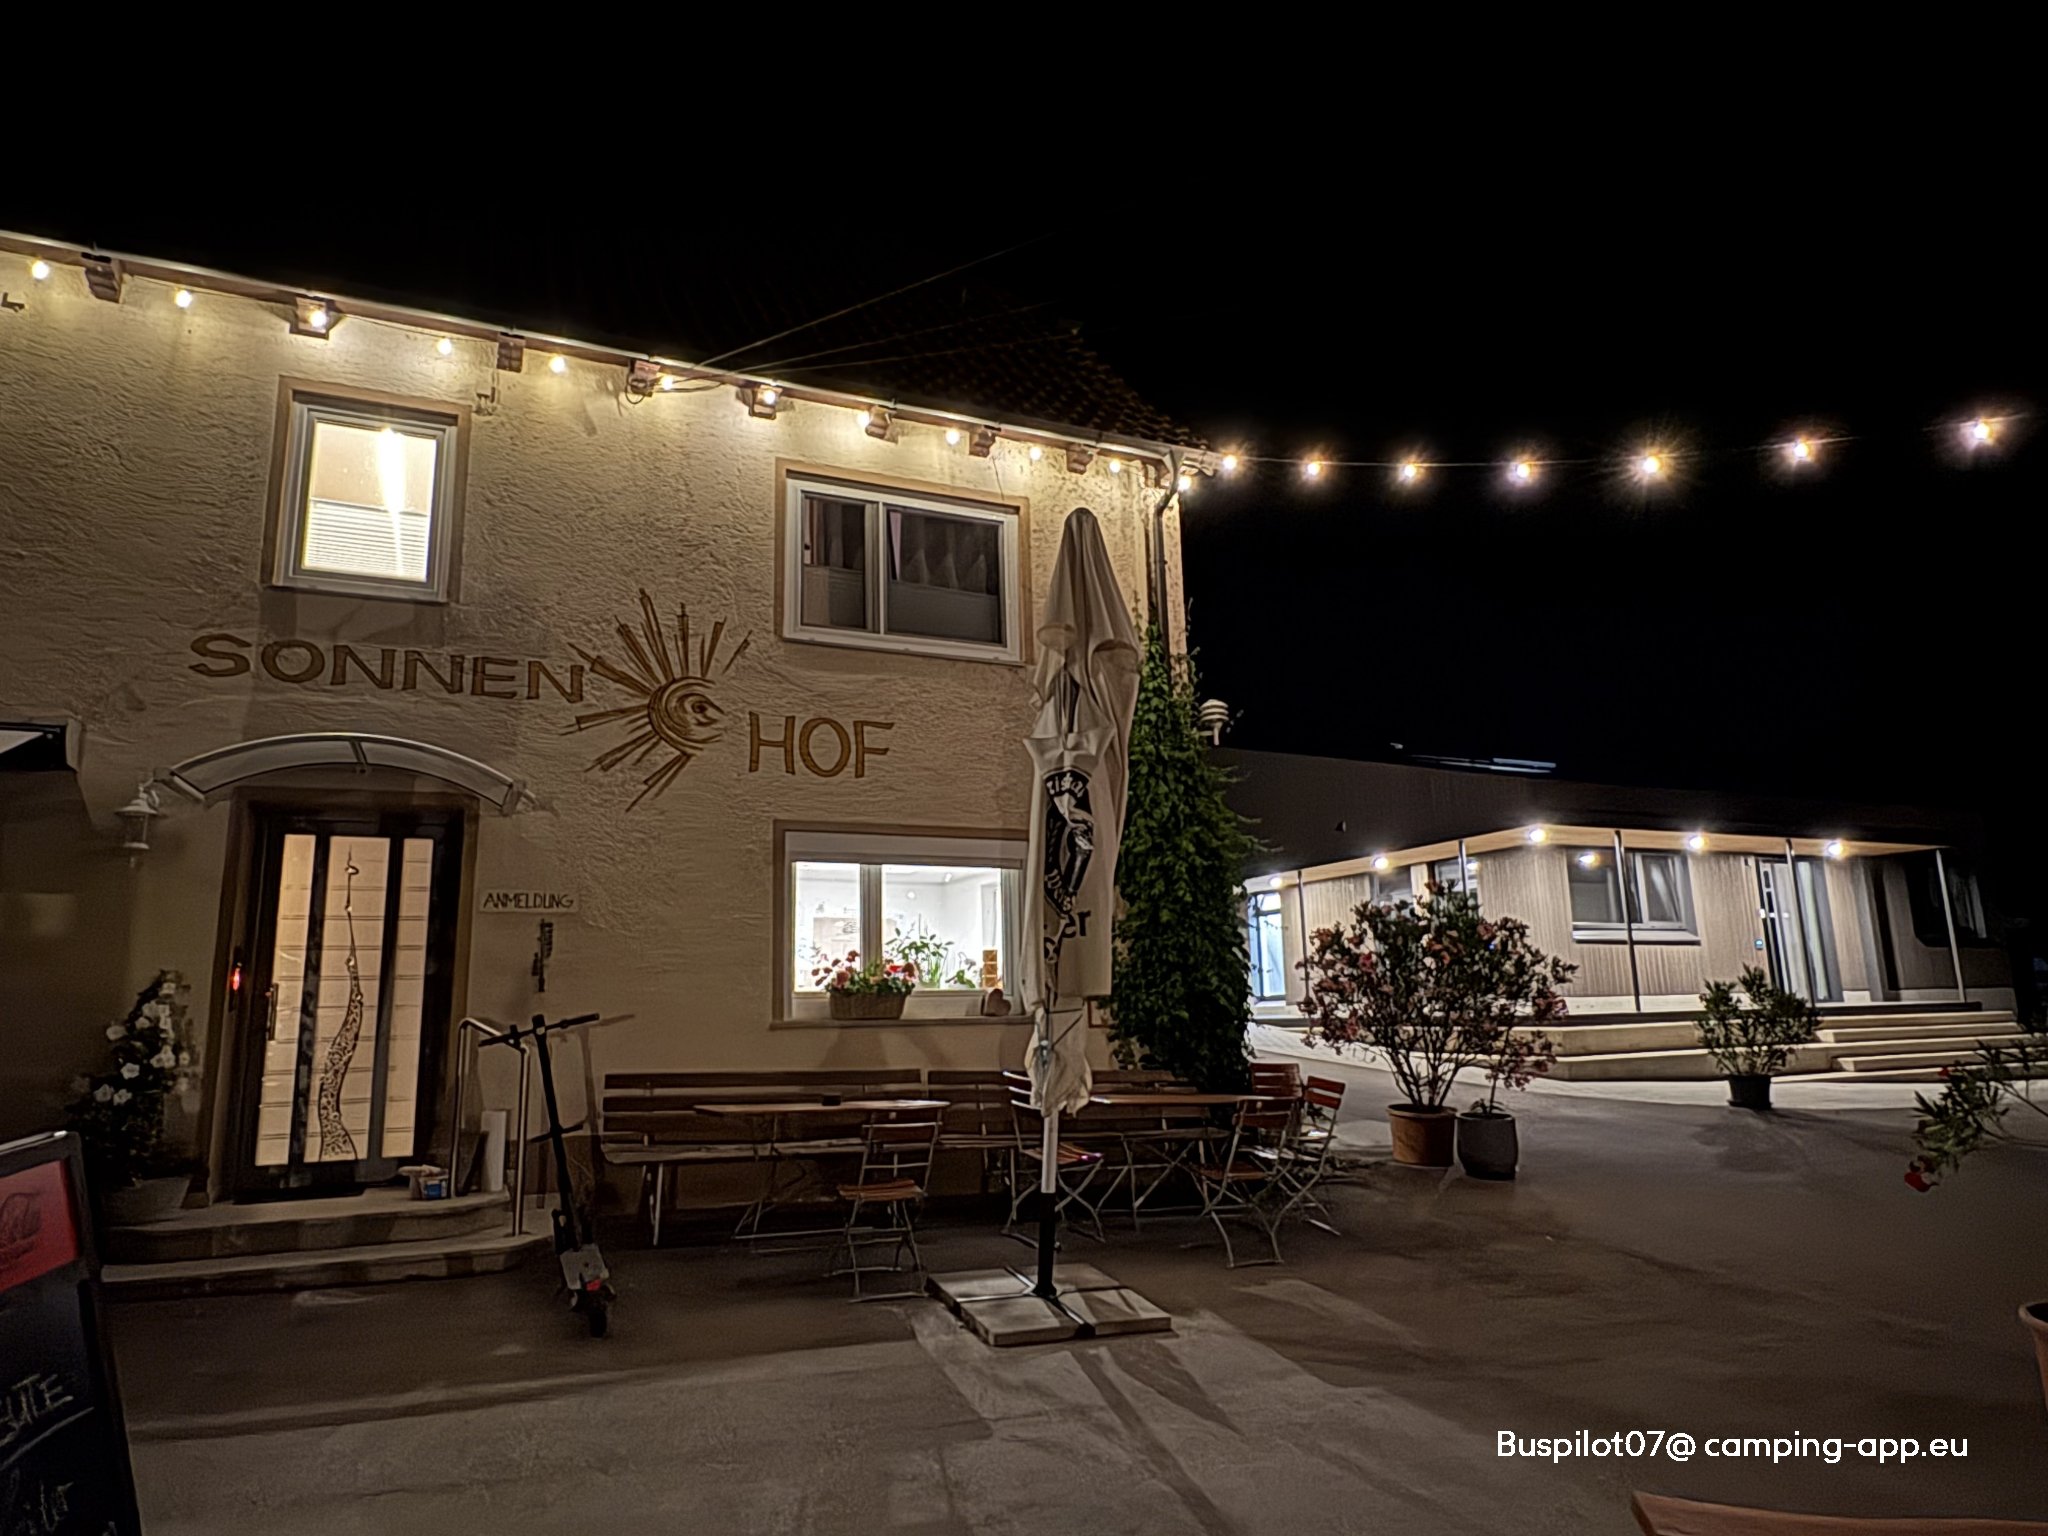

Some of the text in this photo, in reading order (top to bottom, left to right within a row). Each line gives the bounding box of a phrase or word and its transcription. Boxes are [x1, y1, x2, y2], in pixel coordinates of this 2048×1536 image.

[188, 633, 895, 779] SONNEN HOF
[483, 892, 574, 909] ANMELDUNG
